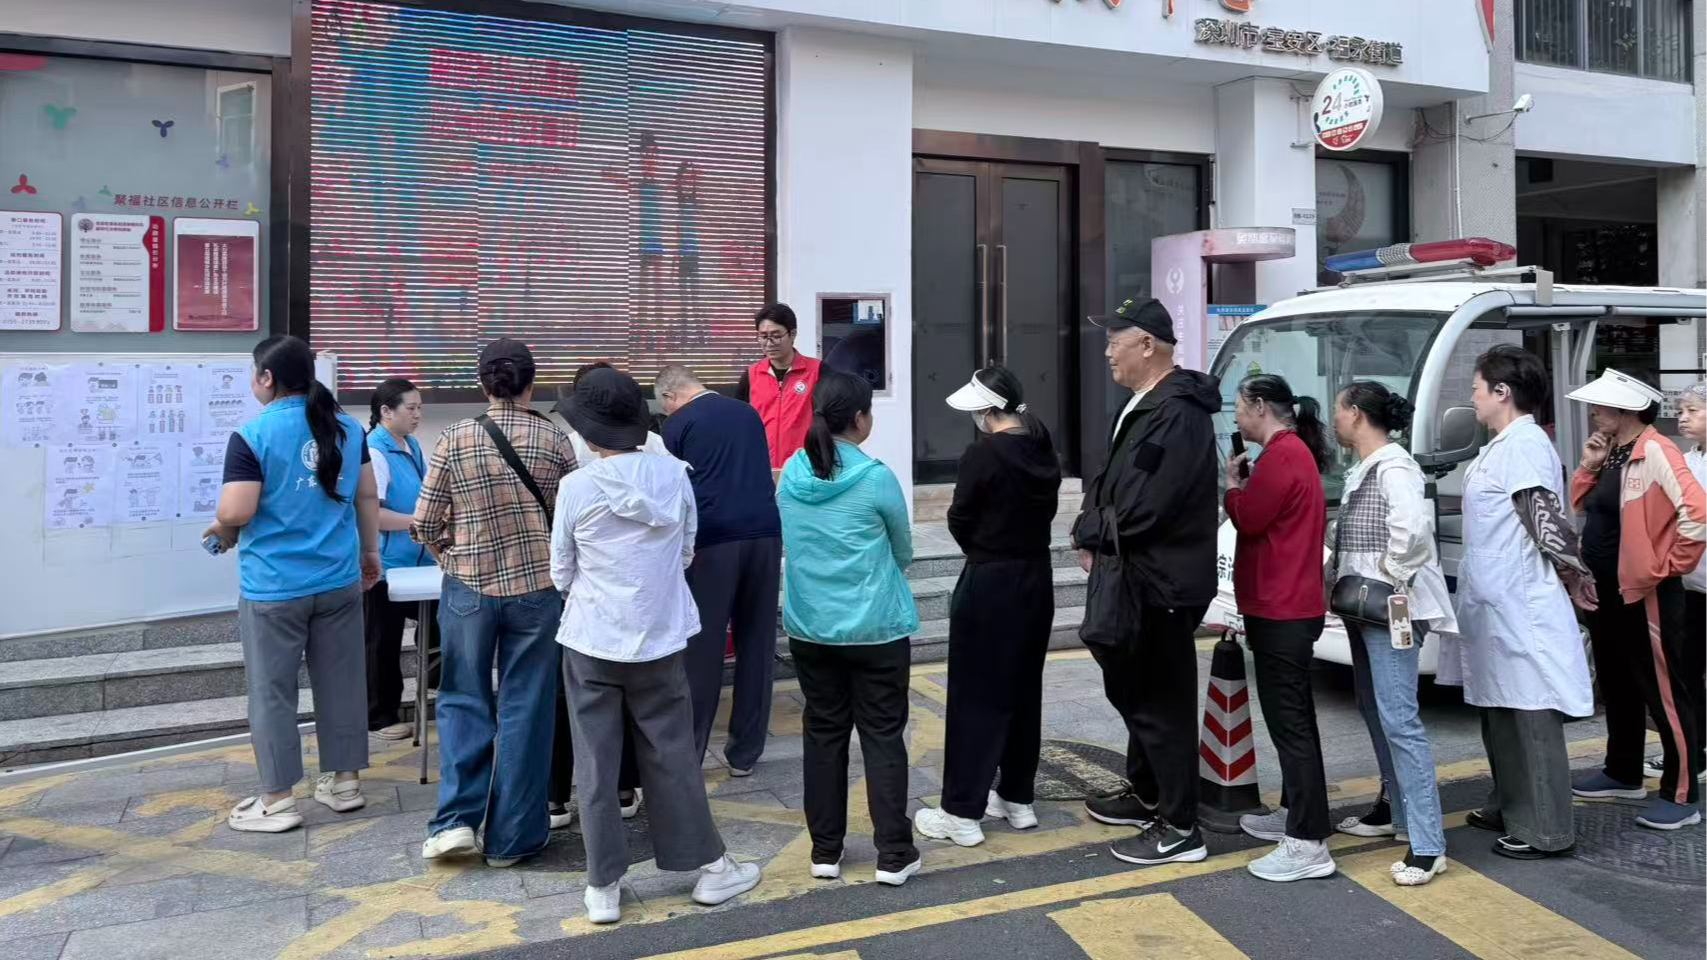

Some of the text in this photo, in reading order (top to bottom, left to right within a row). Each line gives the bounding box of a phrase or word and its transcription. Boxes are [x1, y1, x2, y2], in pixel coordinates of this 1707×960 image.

[114, 193, 239, 210] 聚福社区信息公开栏
